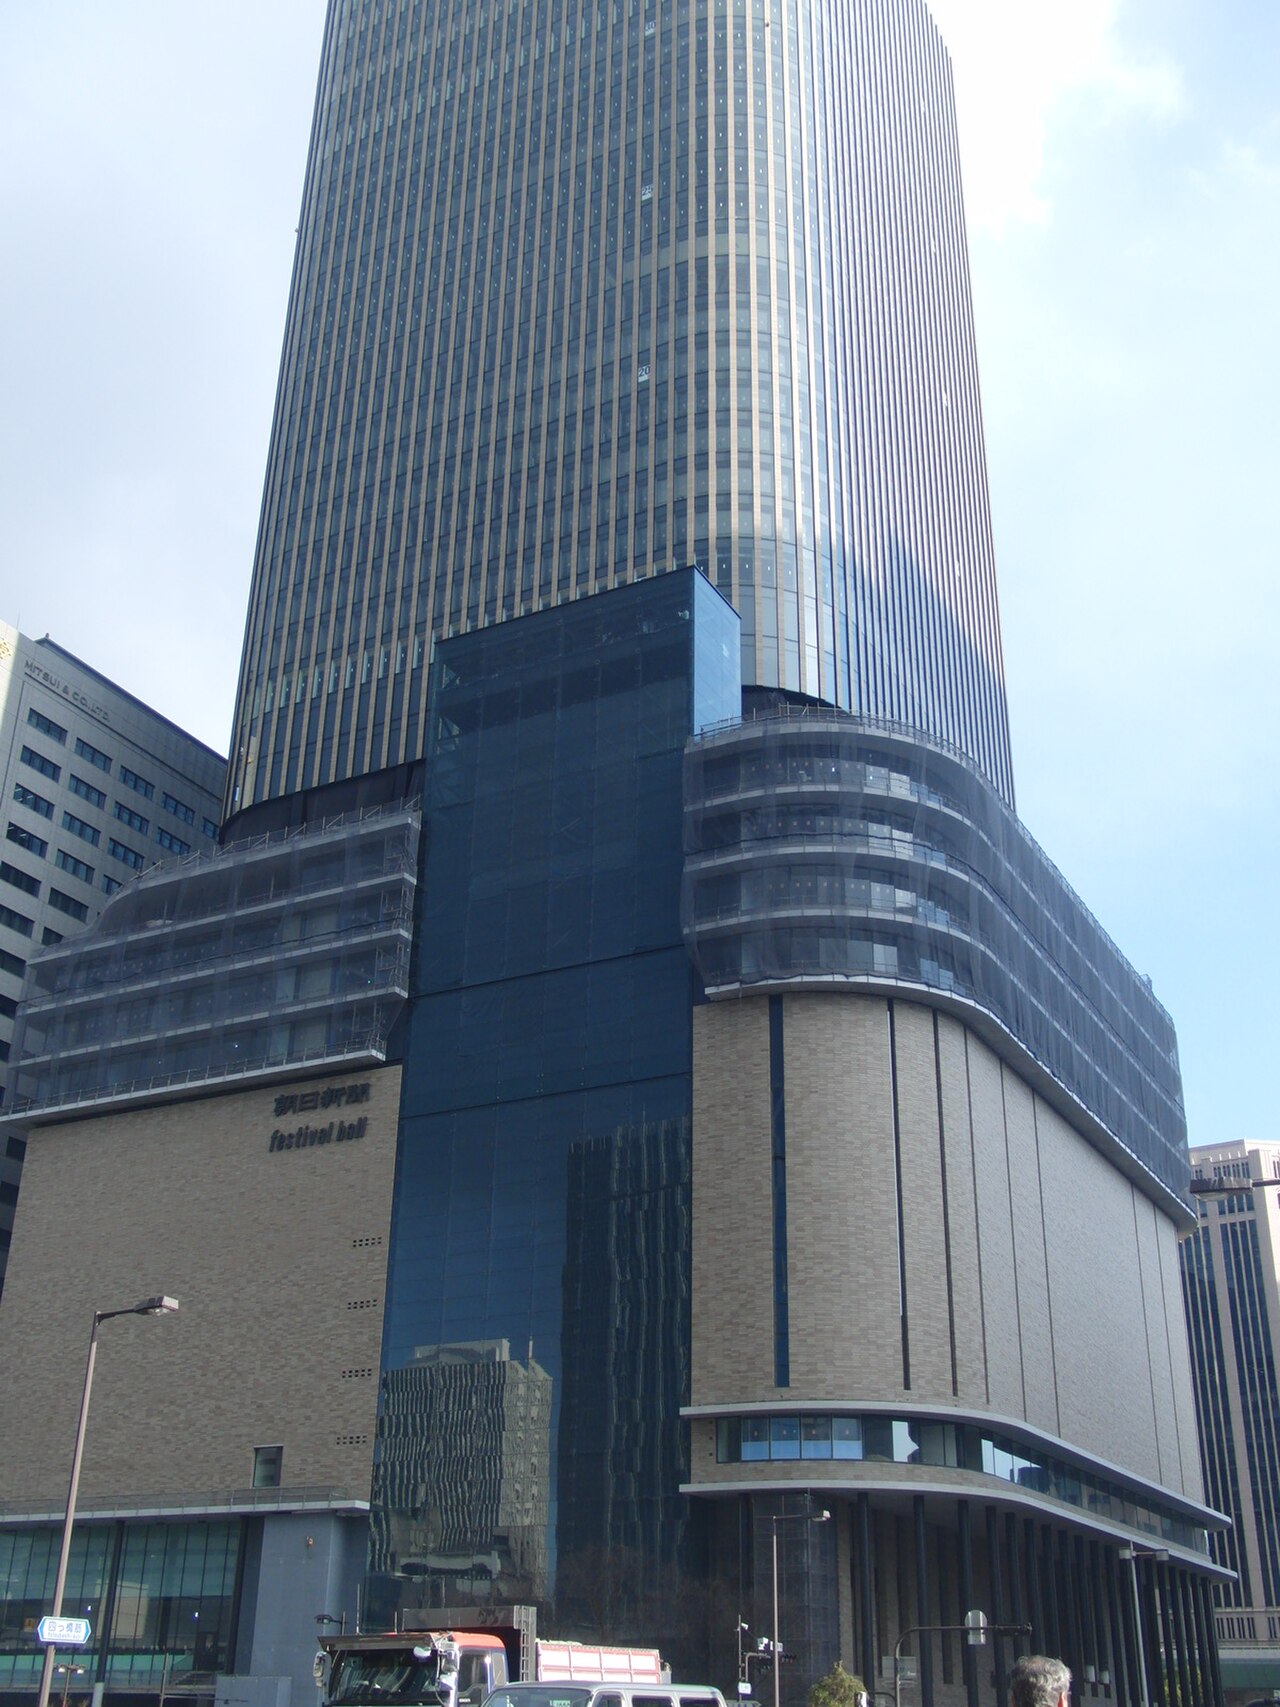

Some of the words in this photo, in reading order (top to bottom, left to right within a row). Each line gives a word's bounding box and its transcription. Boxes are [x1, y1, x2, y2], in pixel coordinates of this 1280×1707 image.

[638, 366, 651, 377] 20
[24, 660, 60, 689] MITSUI
[62, 684, 70, 696] &
[273, 1082, 370, 1117] 朝日新聞
[269, 1121, 334, 1153] festival
[336, 1116, 368, 1142] hall
